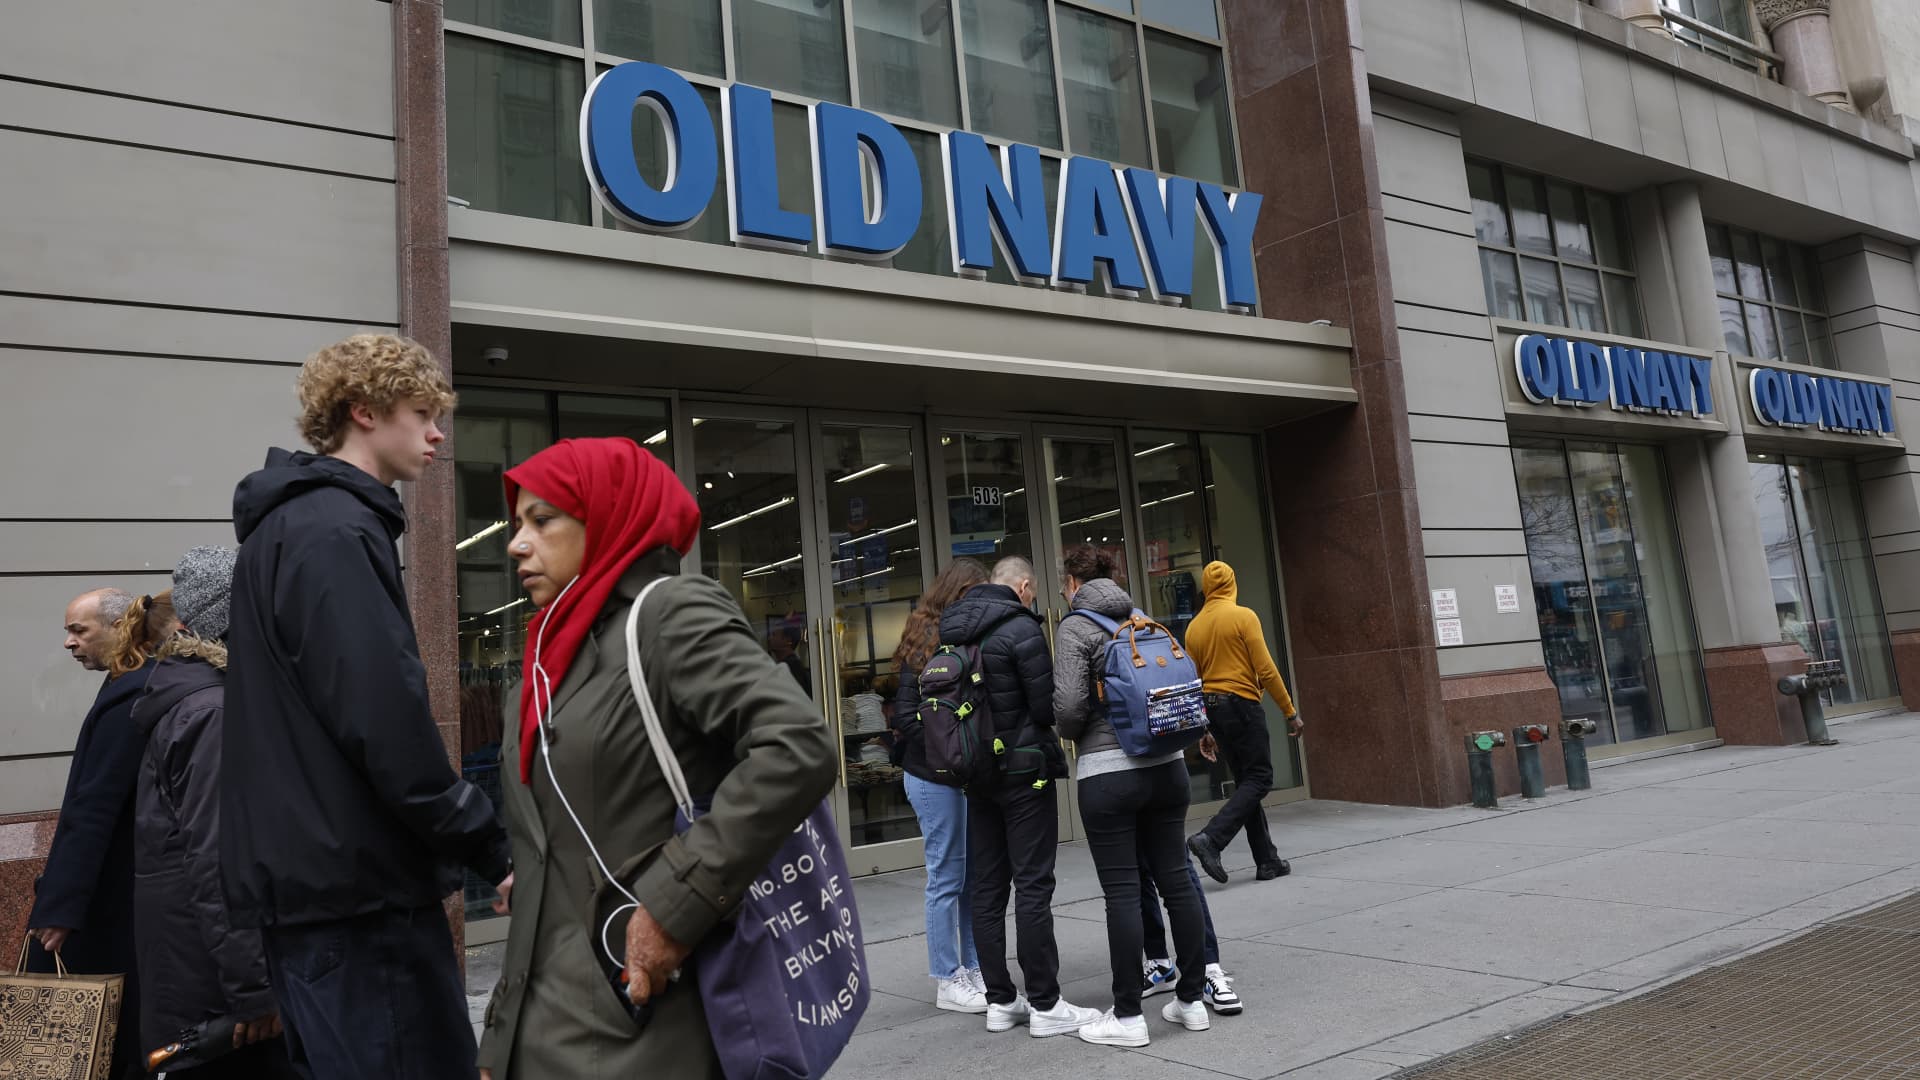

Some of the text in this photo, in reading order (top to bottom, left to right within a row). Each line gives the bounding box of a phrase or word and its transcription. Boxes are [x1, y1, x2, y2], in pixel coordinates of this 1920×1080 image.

[580, 61, 1263, 312] OLD NAVY
[1515, 334, 1713, 418] OLD NAVY
[1750, 368, 1896, 437] OLD NAVY
[974, 487, 1000, 505] 503
[764, 875, 844, 938] THE AE
[784, 925, 847, 979] BKLYN
